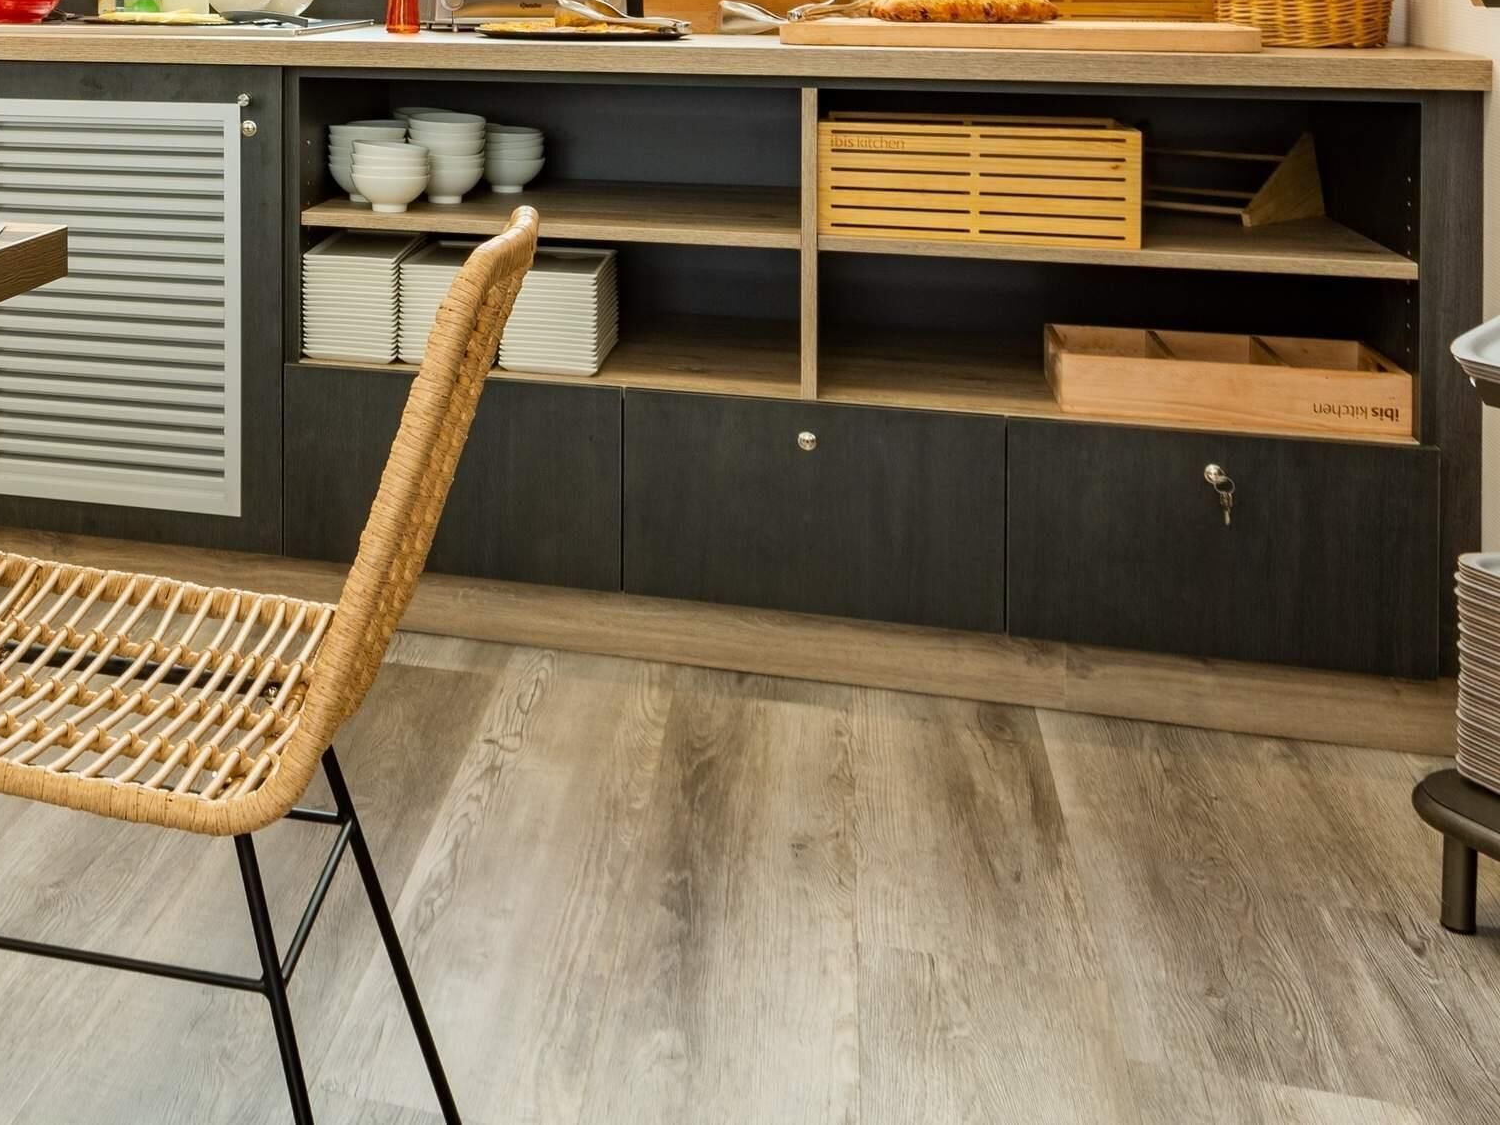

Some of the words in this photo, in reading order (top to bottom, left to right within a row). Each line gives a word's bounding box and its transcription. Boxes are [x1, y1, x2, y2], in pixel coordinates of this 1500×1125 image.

[830, 136, 854, 148] ibis
[856, 136, 905, 149] kitchen
[1313, 403, 1368, 420] kitchen
[1371, 406, 1399, 422] ibis
